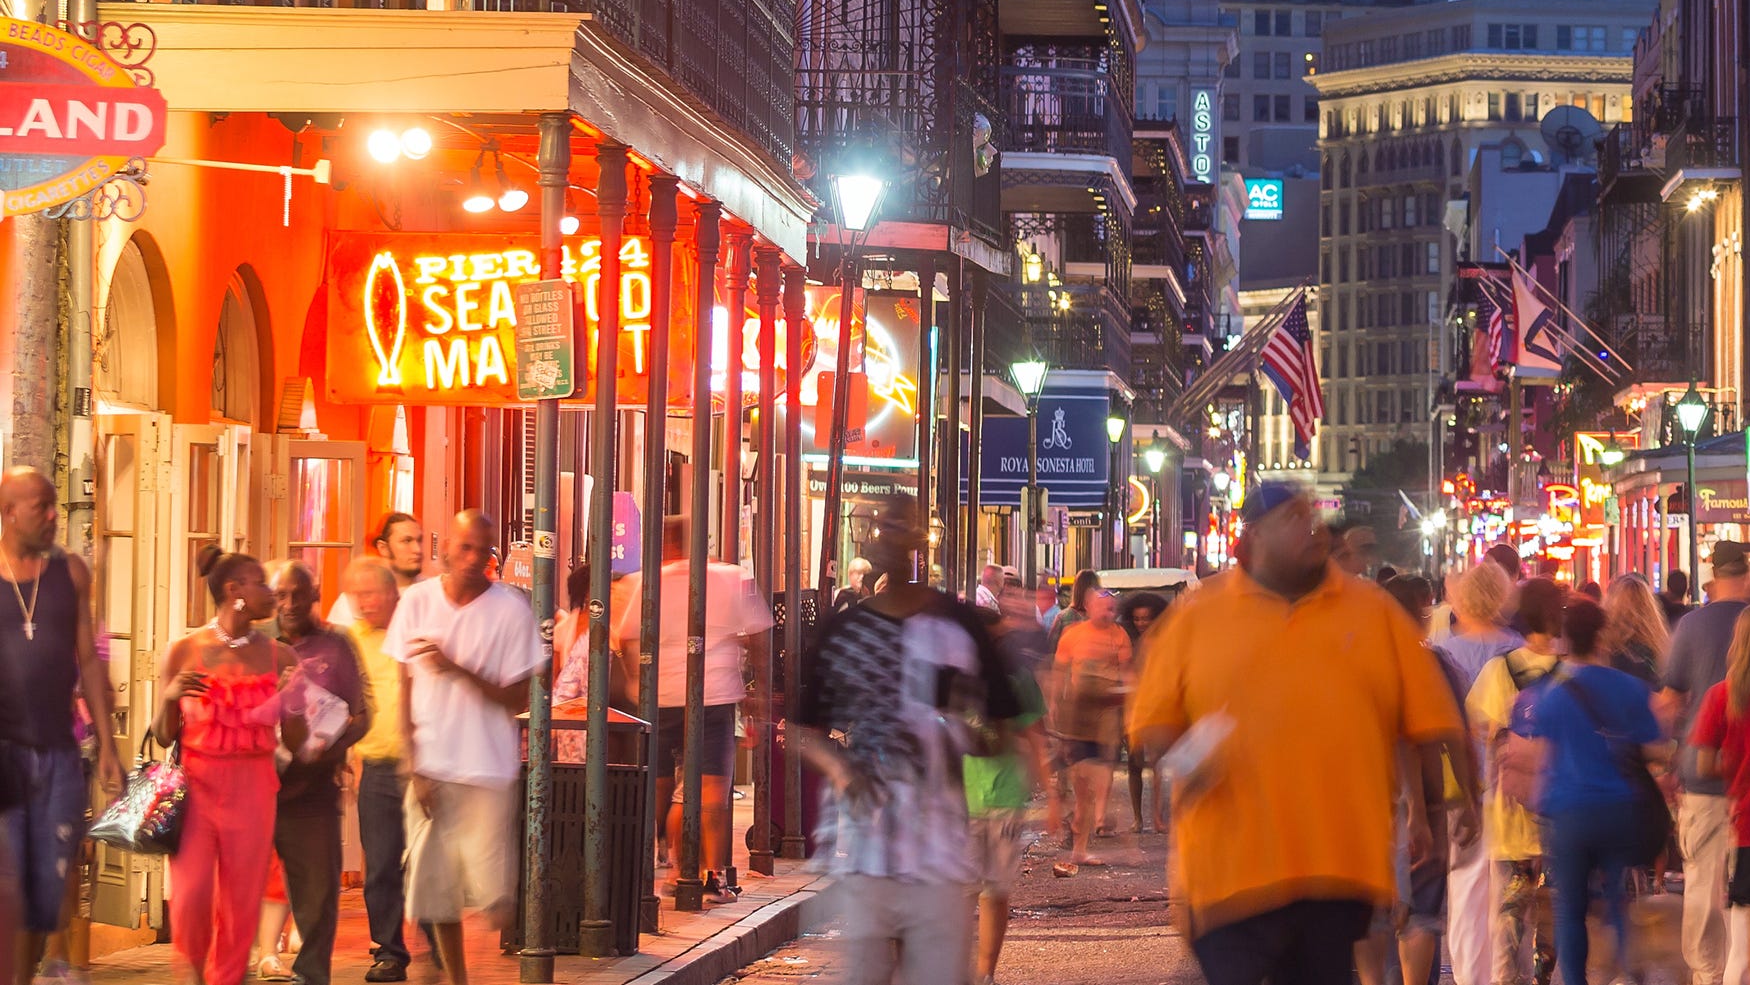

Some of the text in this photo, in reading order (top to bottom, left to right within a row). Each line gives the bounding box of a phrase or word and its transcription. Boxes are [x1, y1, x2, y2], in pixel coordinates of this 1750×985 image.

[7, 159, 111, 210] CIGARETTES
[1248, 184, 1278, 201] AC
[414, 249, 541, 284] PIER
[1000, 457, 1095, 473] ROYA SONESTA HOTEL
[861, 482, 891, 494] Beers
[1699, 488, 1749, 511] Famous
[1069, 517, 1092, 526] onti
